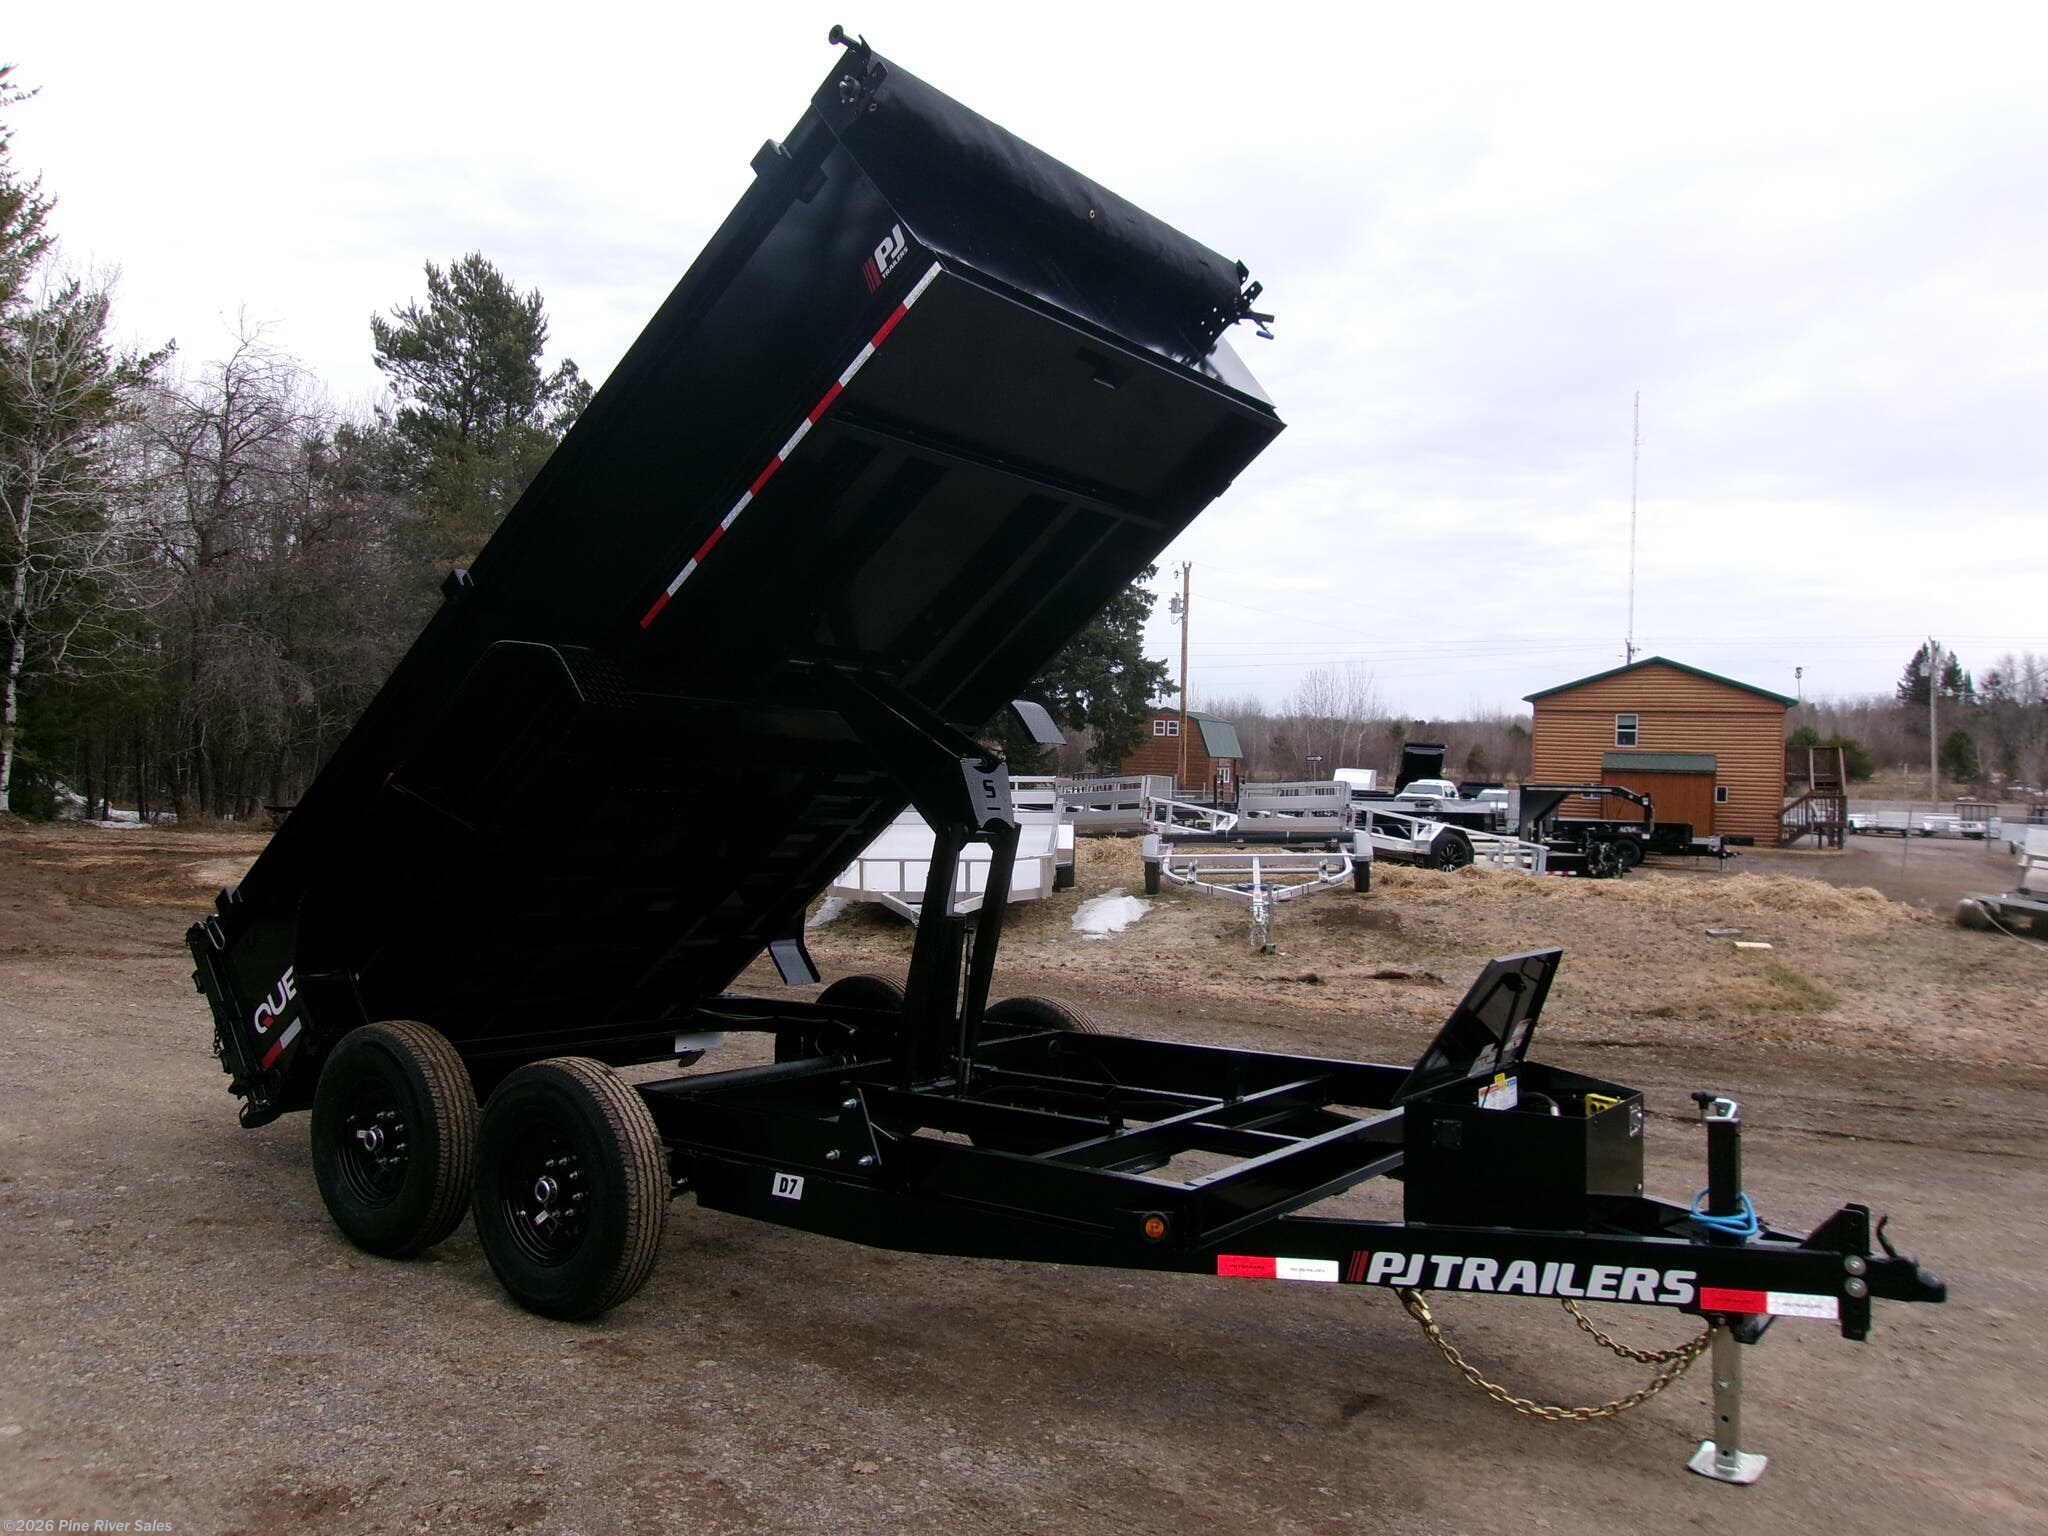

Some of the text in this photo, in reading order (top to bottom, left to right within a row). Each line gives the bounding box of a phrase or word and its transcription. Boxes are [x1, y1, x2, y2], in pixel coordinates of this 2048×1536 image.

[874, 223, 905, 273] PJ
[881, 246, 909, 279] TRAILERS
[779, 1176, 798, 1194] D7
[1366, 1251, 1697, 1304] PJ TRAILERS
